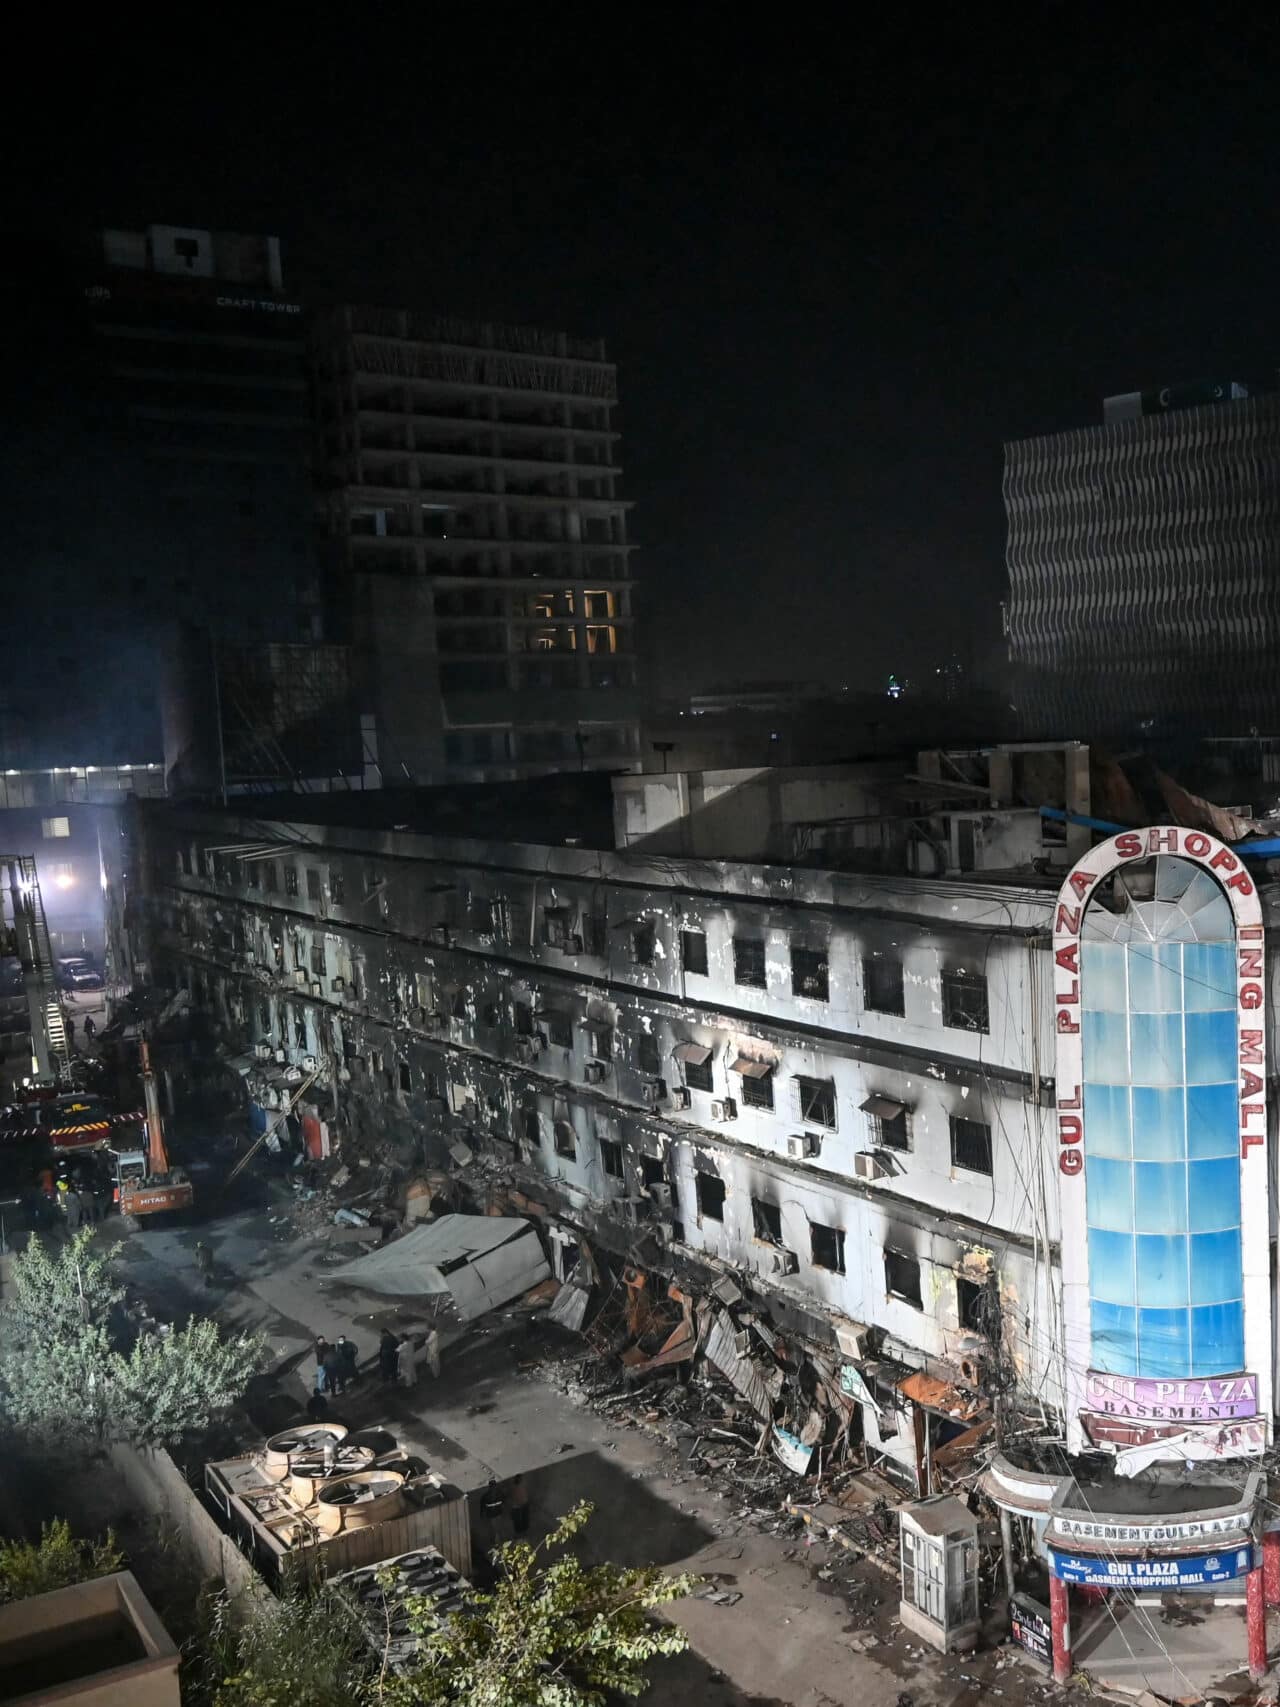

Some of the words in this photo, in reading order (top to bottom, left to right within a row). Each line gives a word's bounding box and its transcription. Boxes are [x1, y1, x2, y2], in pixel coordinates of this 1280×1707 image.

[1055, 869, 1098, 1034] PLAZA
[1239, 1029, 1265, 1160] MALL
[1059, 1085, 1084, 1176] GUL
[1156, 1379, 1256, 1405] PLAZA
[1104, 1400, 1239, 1419] BASEMENT
[1107, 1563, 1134, 1576] GUL
[1136, 1562, 1180, 1576] PLAZA
[1129, 1574, 1179, 1586] SHOPPING
[1180, 1573, 1204, 1585] MALL
